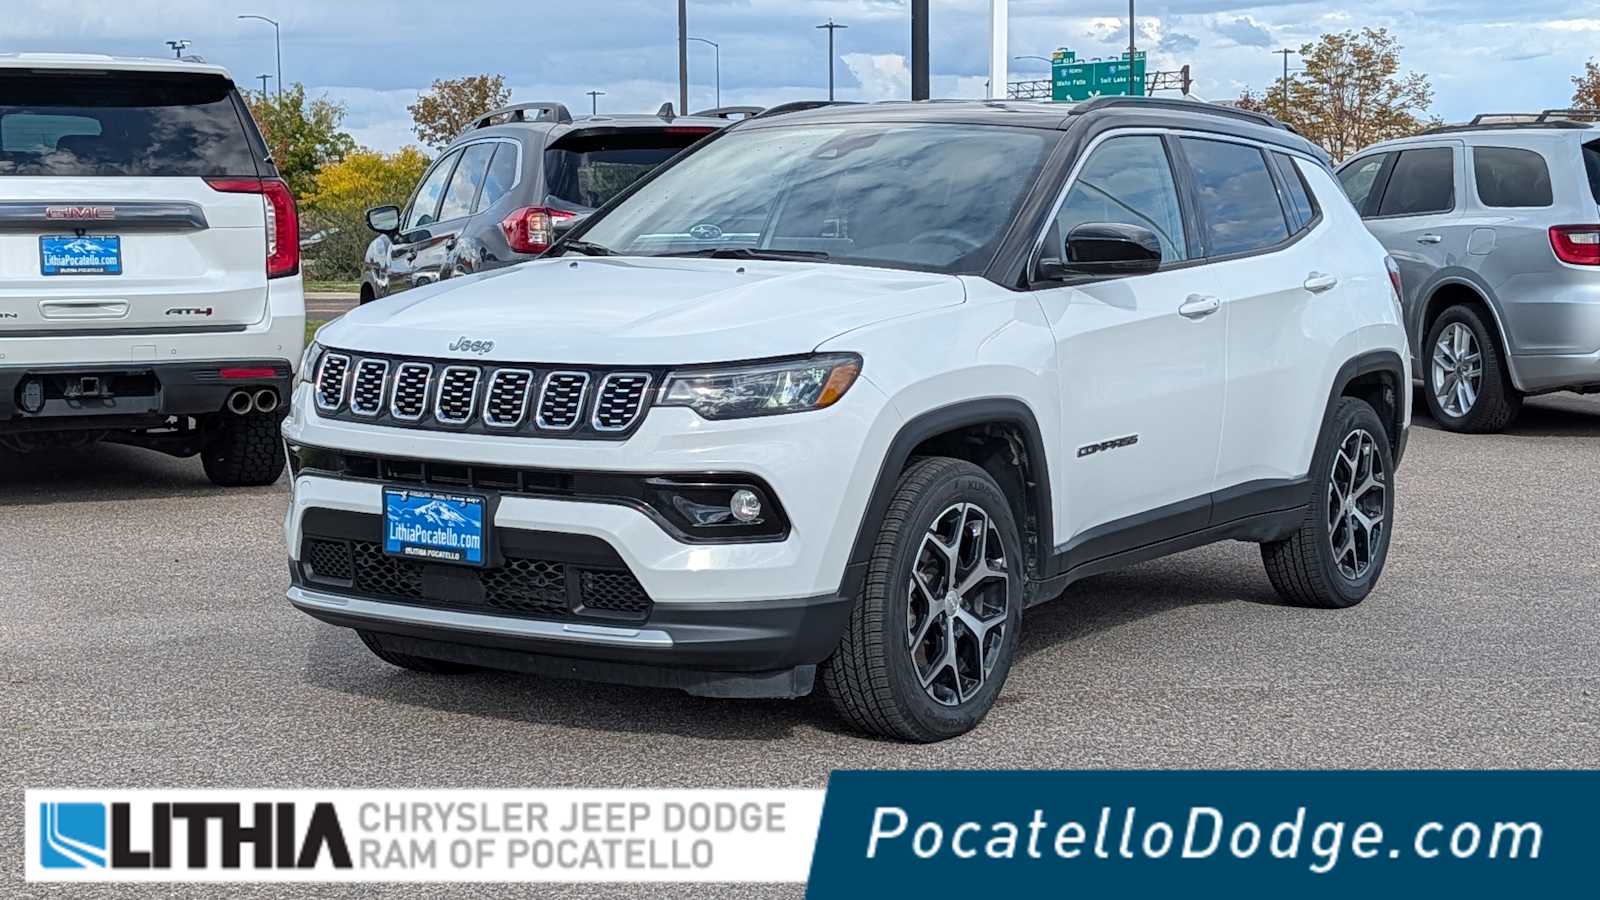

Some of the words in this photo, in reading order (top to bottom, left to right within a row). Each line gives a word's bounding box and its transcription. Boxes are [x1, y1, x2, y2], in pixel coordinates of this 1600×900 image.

[46, 207, 115, 220] GMC
[44, 254, 118, 266] LithiaPocatello.com
[448, 335, 494, 356] Jeep
[1077, 433, 1139, 458] COMPASS
[389, 521, 481, 550] LithiaPocatello.com
